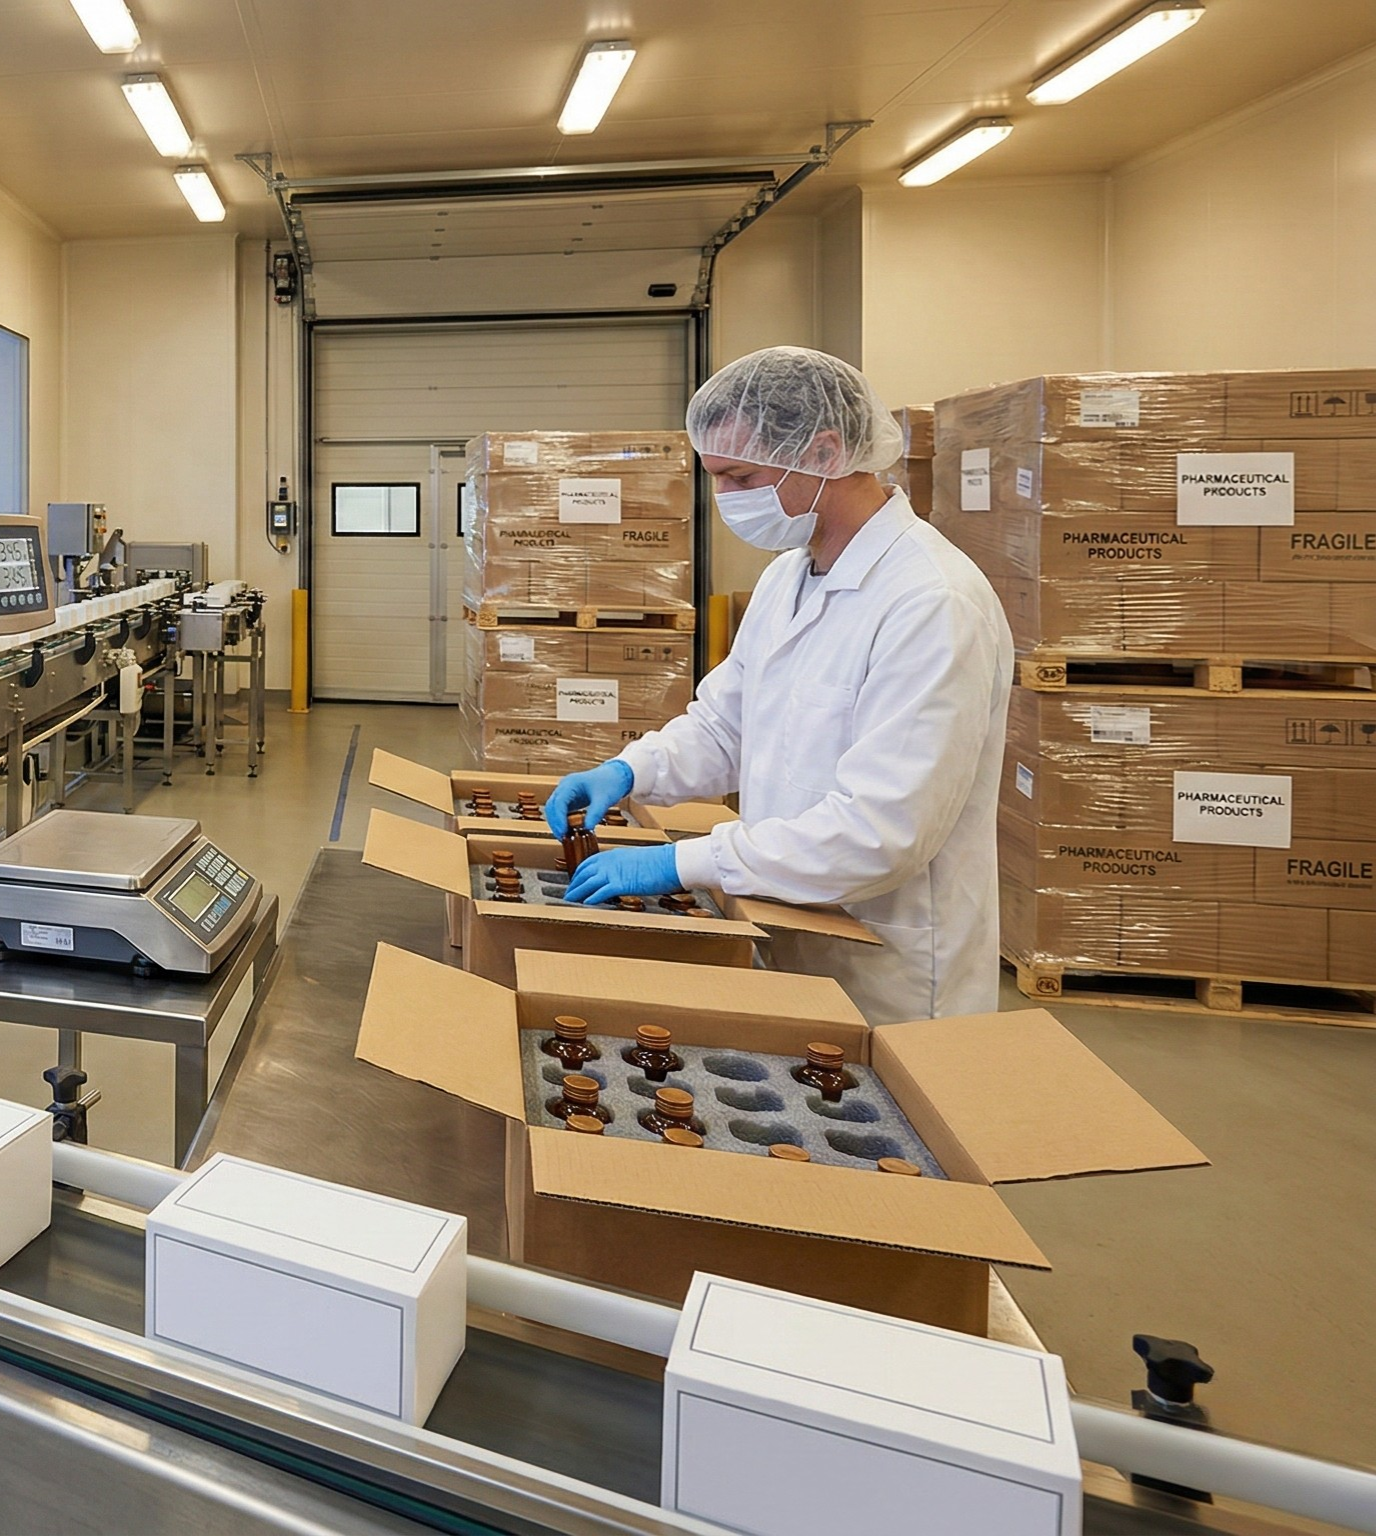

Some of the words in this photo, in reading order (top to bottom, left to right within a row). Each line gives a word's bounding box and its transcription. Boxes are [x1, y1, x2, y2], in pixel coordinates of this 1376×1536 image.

[1181, 474, 1290, 484] PHARMACEUTICAL
[622, 531, 670, 542] FRAGILE
[1063, 533, 1188, 545] PHARMACEUTICAL
[1291, 533, 1376, 550] FRAGILE
[1088, 548, 1162, 560] PRODUCTS
[1177, 791, 1285, 806] PHARMACEUTICAL
[1199, 806, 1263, 817] PRODUCTS
[1059, 846, 1182, 863] PHARMACEUTICAL
[1083, 861, 1157, 876] PRODUCTS
[1287, 858, 1373, 879] FRAGILE
